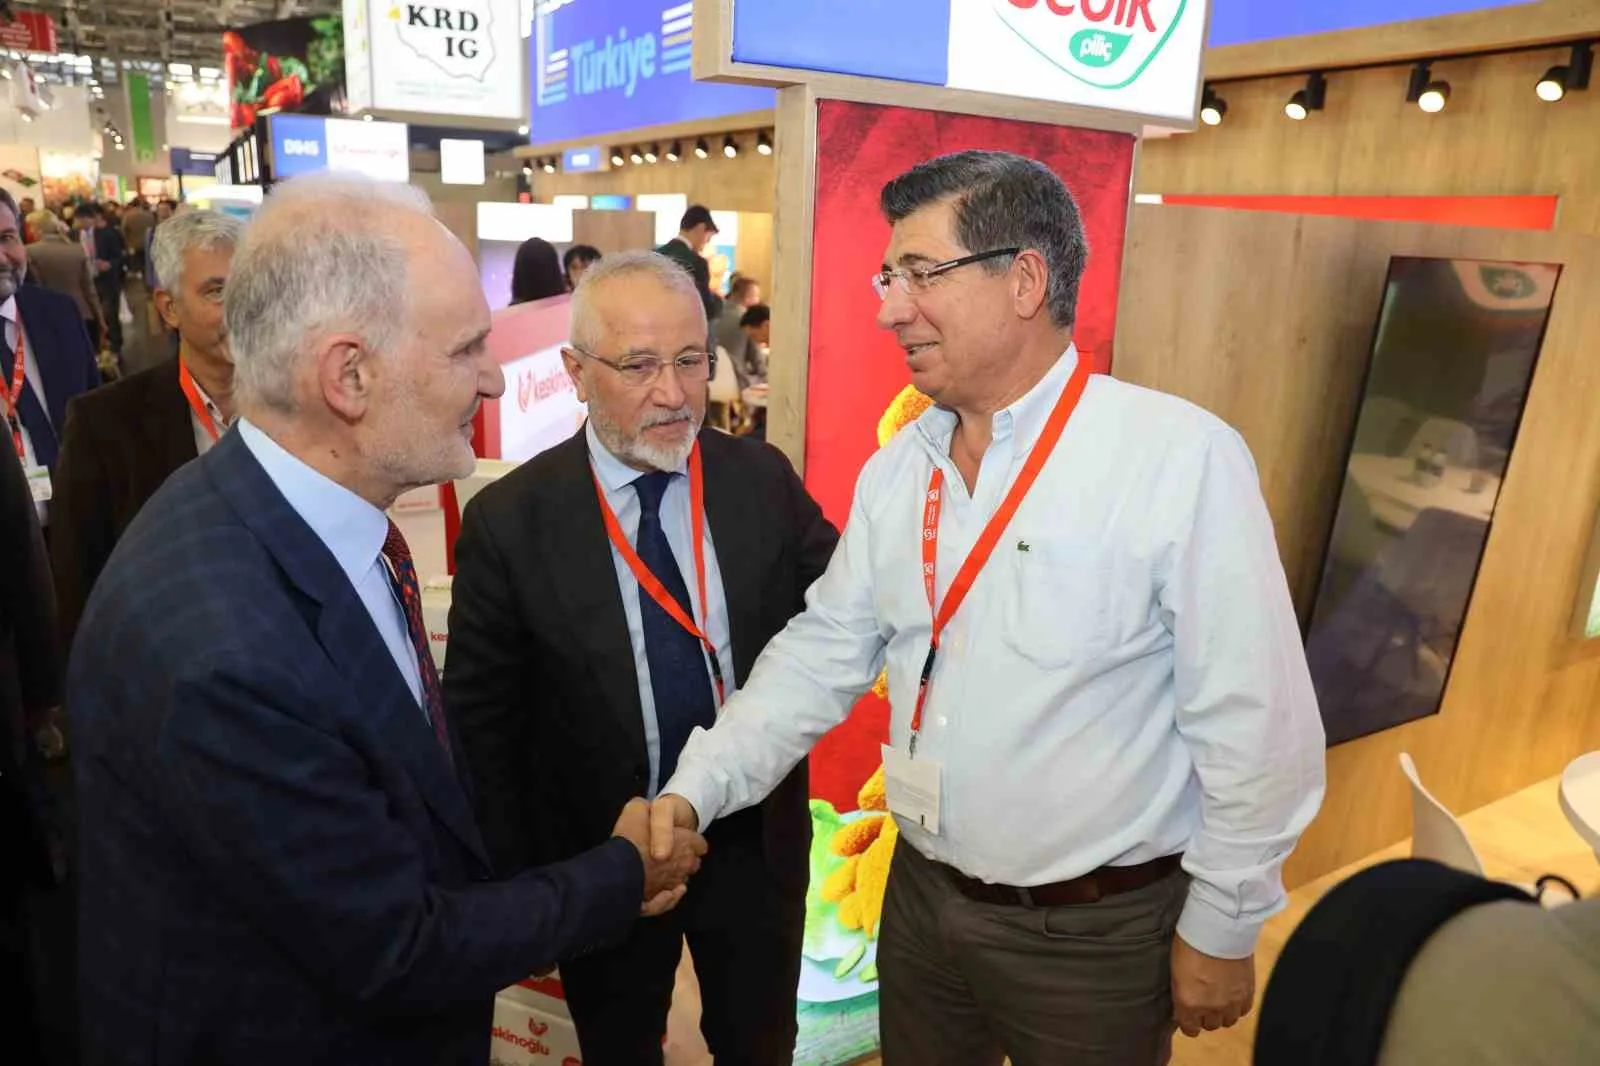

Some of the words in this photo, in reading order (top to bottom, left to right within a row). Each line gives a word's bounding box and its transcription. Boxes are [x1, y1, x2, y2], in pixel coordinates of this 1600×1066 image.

[407, 4, 479, 31] KRD
[445, 36, 479, 59] IG
[571, 26, 656, 98] Türkiye
